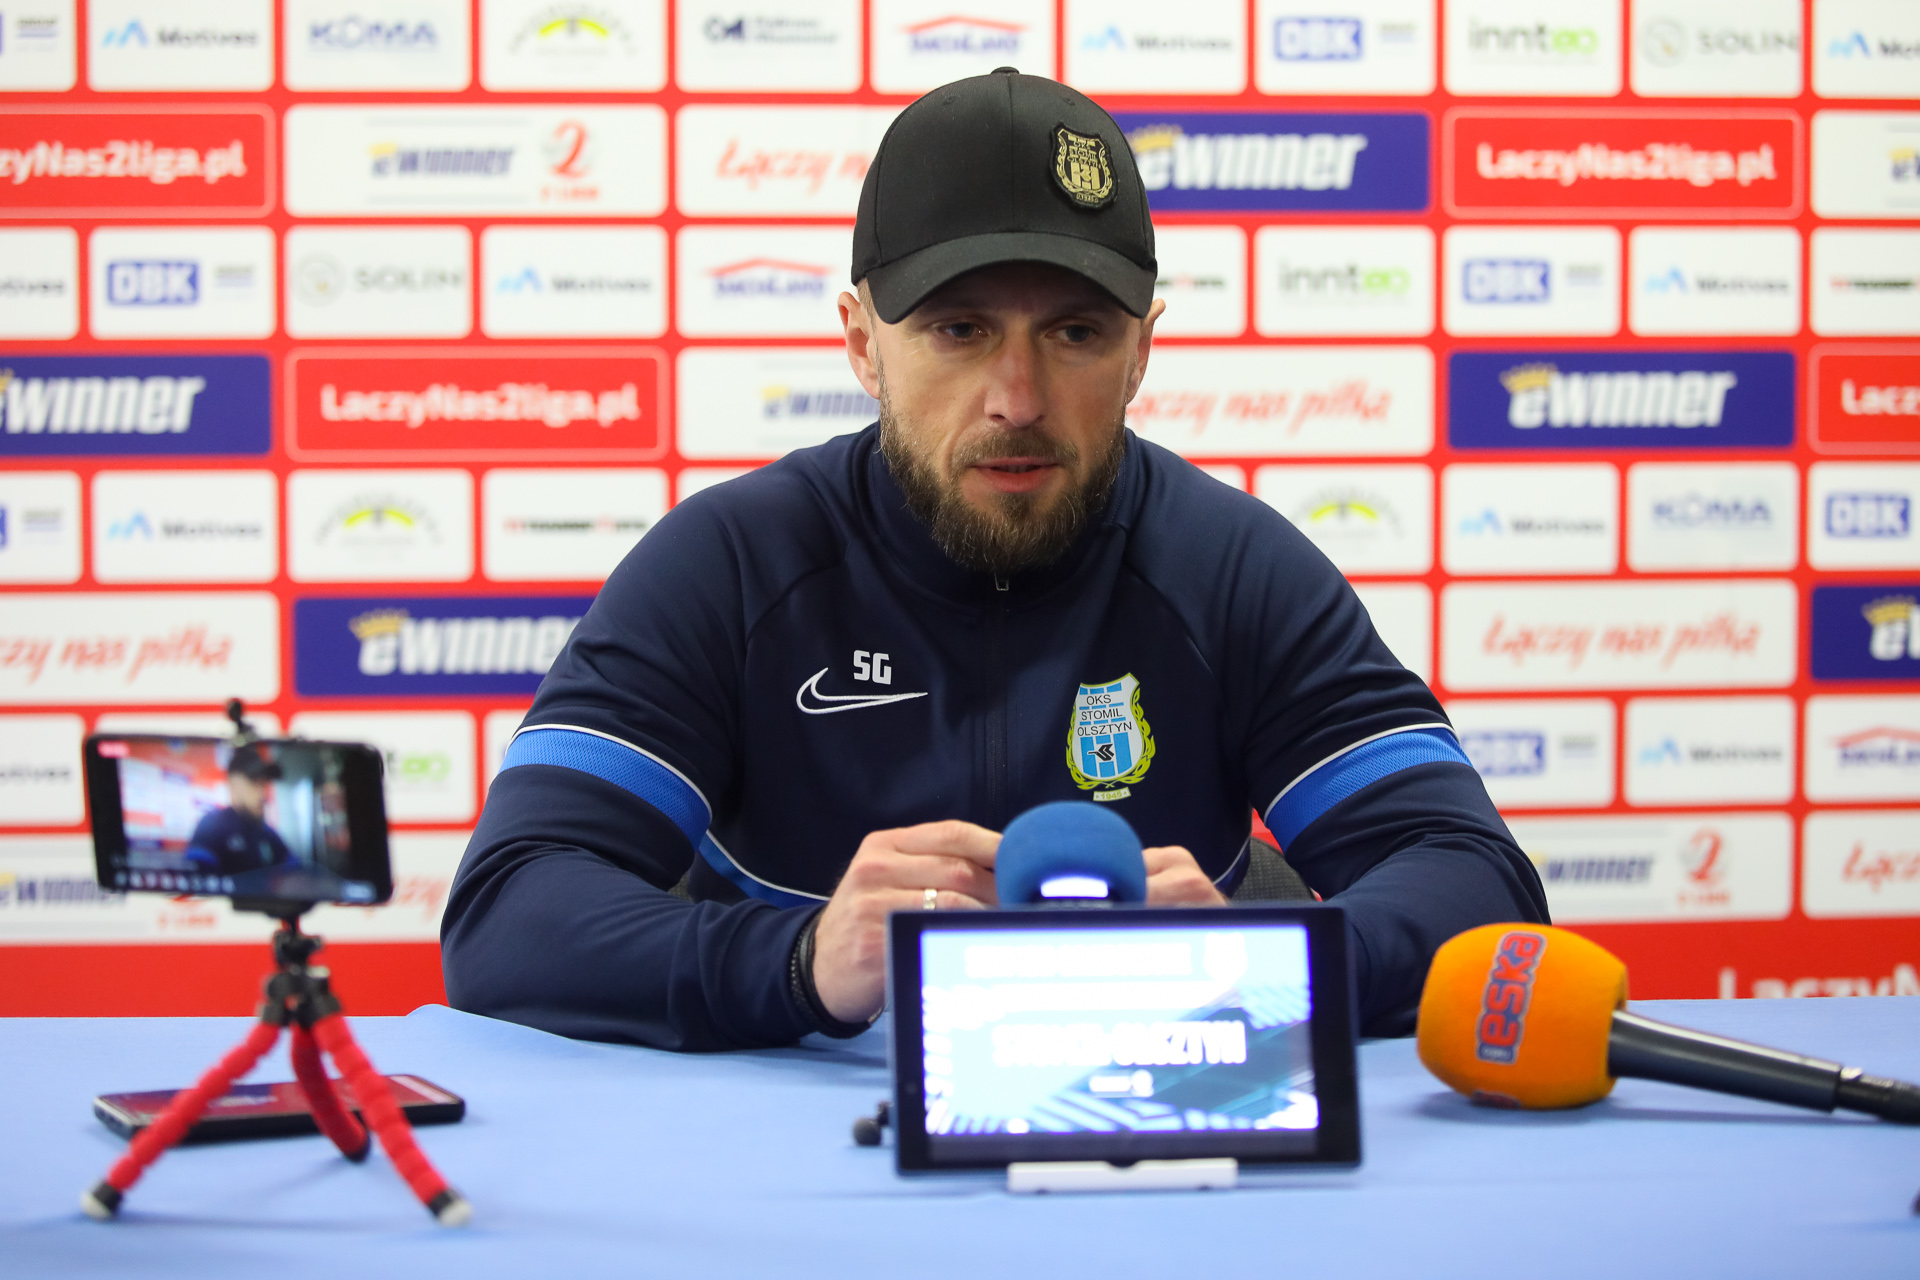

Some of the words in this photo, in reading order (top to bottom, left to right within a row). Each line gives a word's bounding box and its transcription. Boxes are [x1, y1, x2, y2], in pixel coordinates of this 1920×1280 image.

[1277, 20, 1361, 59] DBK
[111, 263, 197, 302] DBK
[853, 649, 892, 685] SG
[1086, 694, 1112, 706] OKS
[1081, 708, 1123, 721] STOMIL
[1077, 721, 1132, 737] OLSZTYN
[1101, 790, 1123, 800] 1945
[1480, 935, 1541, 1047] eska
